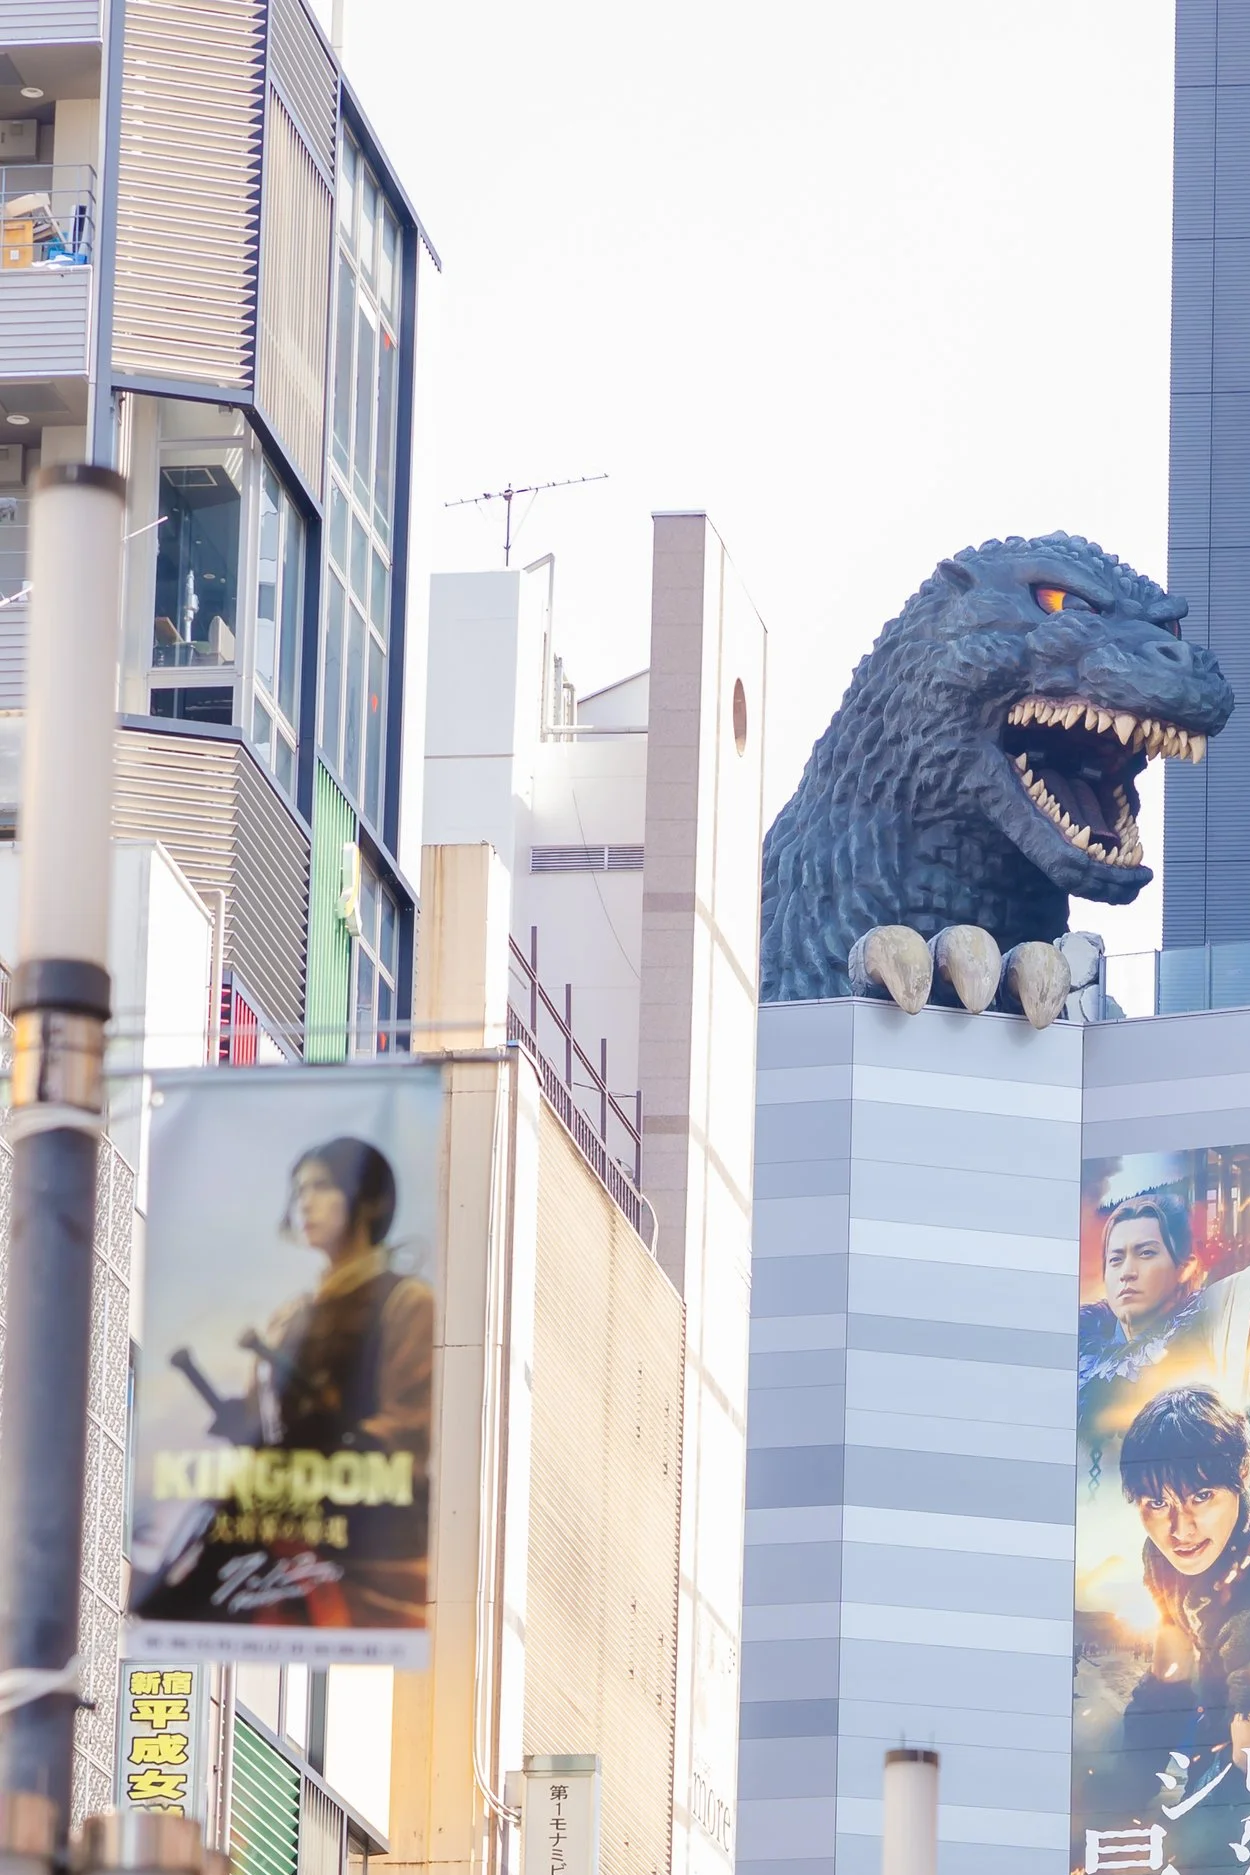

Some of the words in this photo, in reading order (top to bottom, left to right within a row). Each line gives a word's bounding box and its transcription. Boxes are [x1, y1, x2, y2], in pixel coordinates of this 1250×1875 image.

[130, 1671, 193, 1696] 新宿
[127, 1698, 190, 1818] 平成女
[692, 1767, 732, 1855] more
